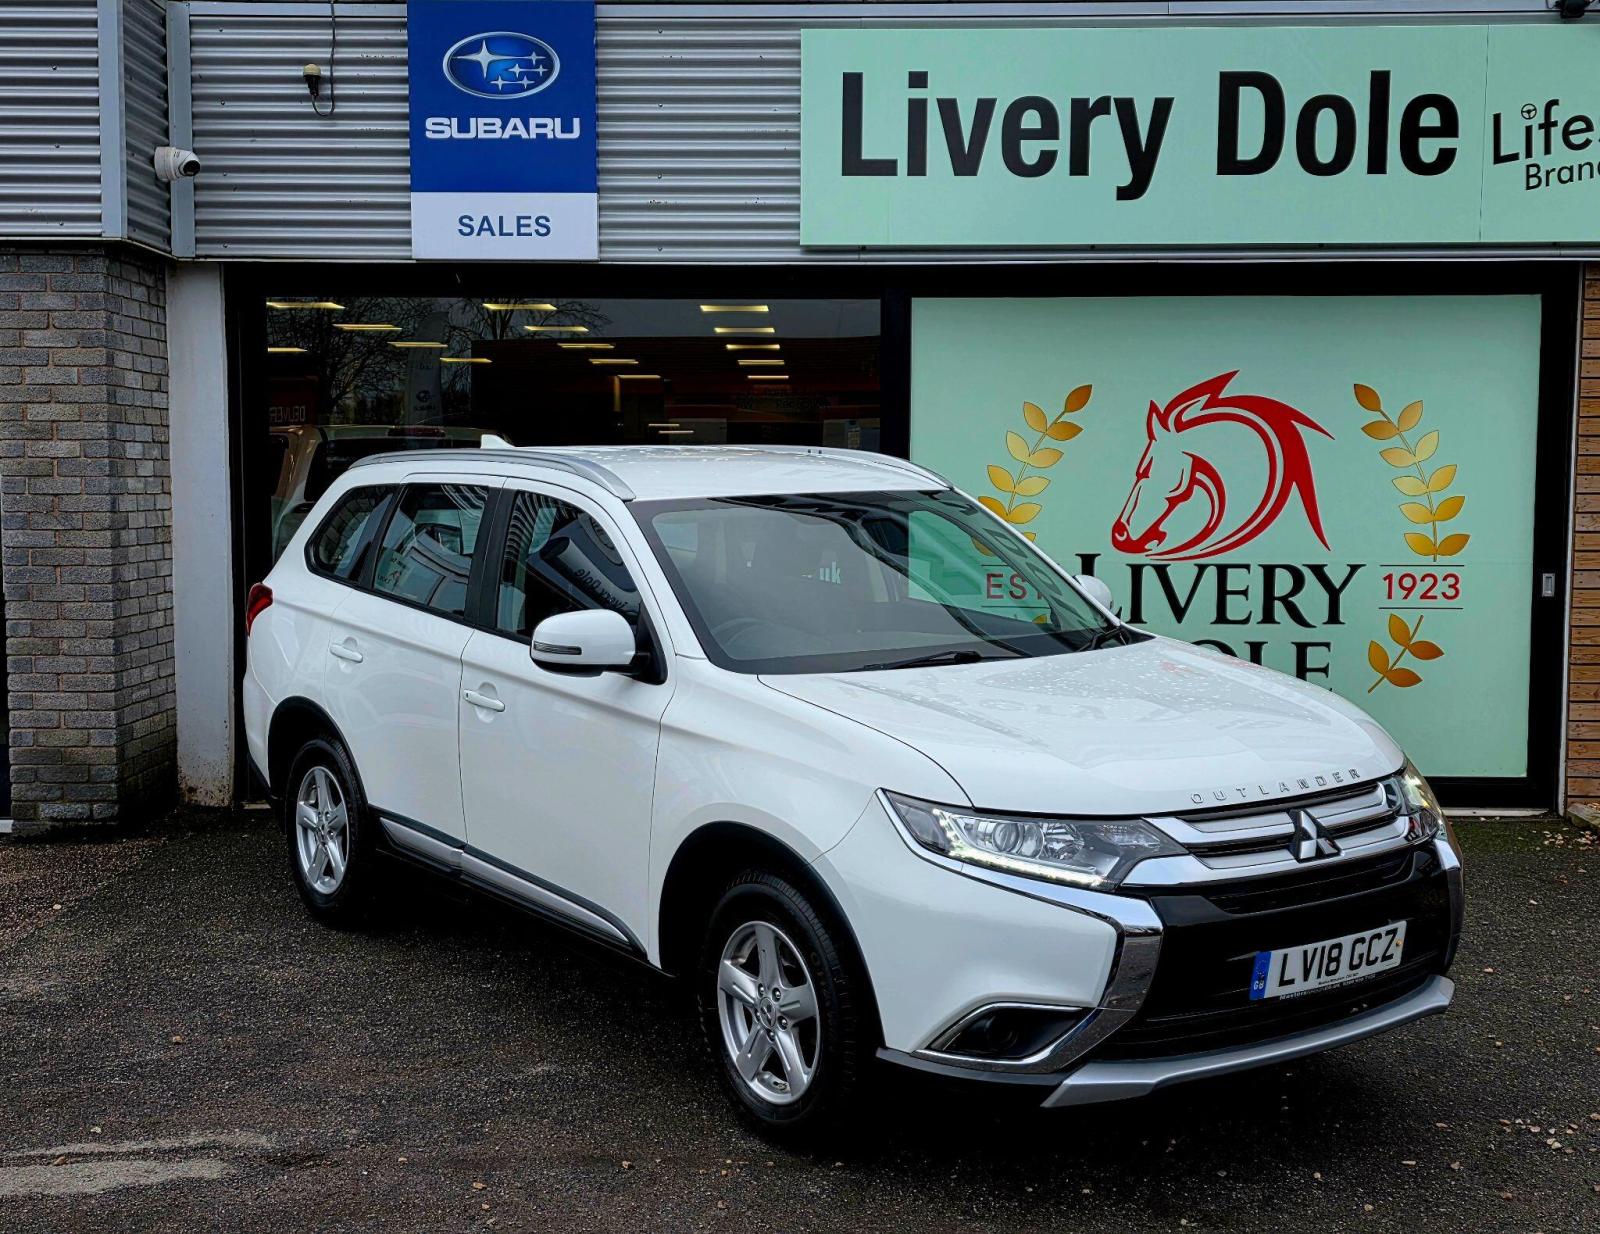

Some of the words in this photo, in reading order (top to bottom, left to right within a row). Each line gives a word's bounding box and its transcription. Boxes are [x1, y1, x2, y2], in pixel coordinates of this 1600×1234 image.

[425, 117, 581, 139] SUBARU
[841, 70, 1175, 201] Livery
[1216, 69, 1459, 177] Dole
[1492, 98, 1600, 165] Life
[1525, 161, 1600, 191] Bran
[457, 214, 551, 237] SALES
[986, 572, 1043, 600] ES
[1382, 572, 1461, 601] 1923
[1190, 768, 1361, 805] OUTLANDER
[1277, 942, 1344, 987] LV18
[1348, 927, 1399, 971] GCZ
[1253, 980, 1264, 991] GB
